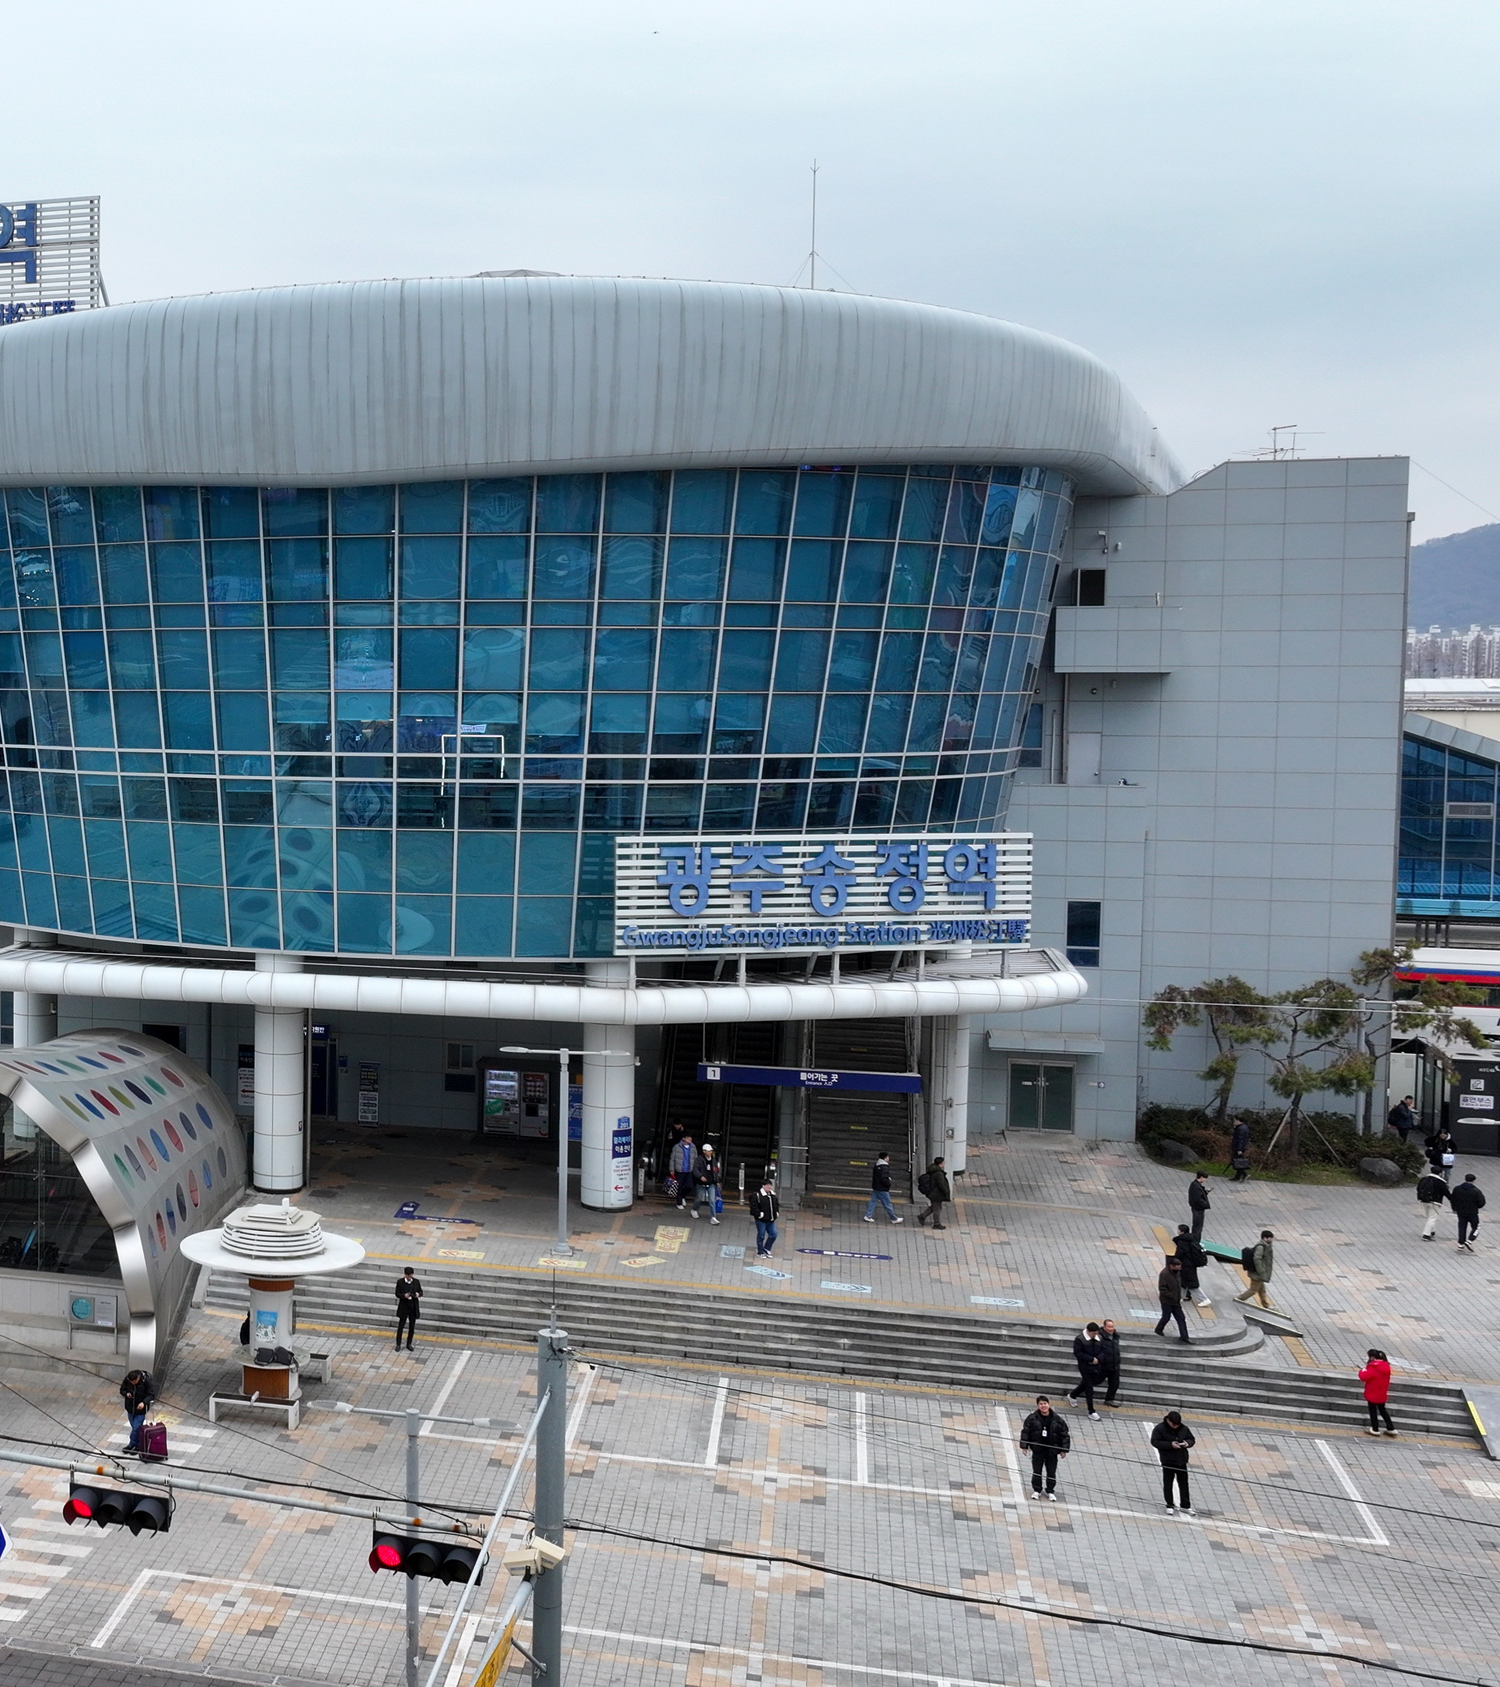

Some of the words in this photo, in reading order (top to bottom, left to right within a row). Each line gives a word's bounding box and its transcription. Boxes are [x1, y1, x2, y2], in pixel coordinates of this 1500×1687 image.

[656, 843, 998, 917] 광주송정역
[623, 924, 840, 950] GwangjuSongjeong
[845, 922, 921, 943] Station
[711, 1069, 717, 1079] 1
